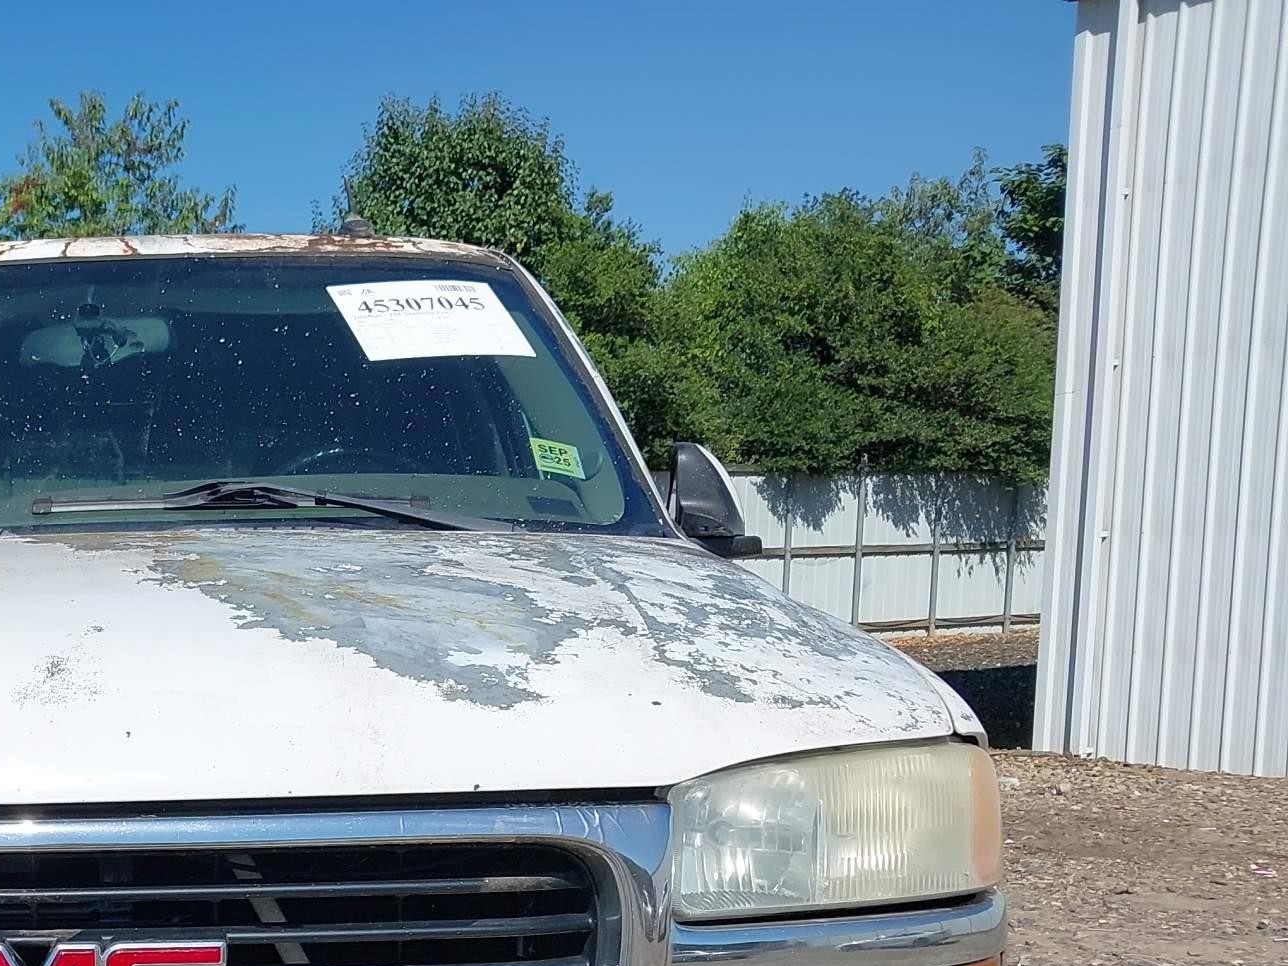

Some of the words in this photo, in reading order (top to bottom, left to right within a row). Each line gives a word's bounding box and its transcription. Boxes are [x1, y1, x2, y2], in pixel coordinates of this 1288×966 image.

[358, 296, 486, 314] 45307045
[537, 443, 569, 457] SEP
[554, 455, 572, 468] 25
